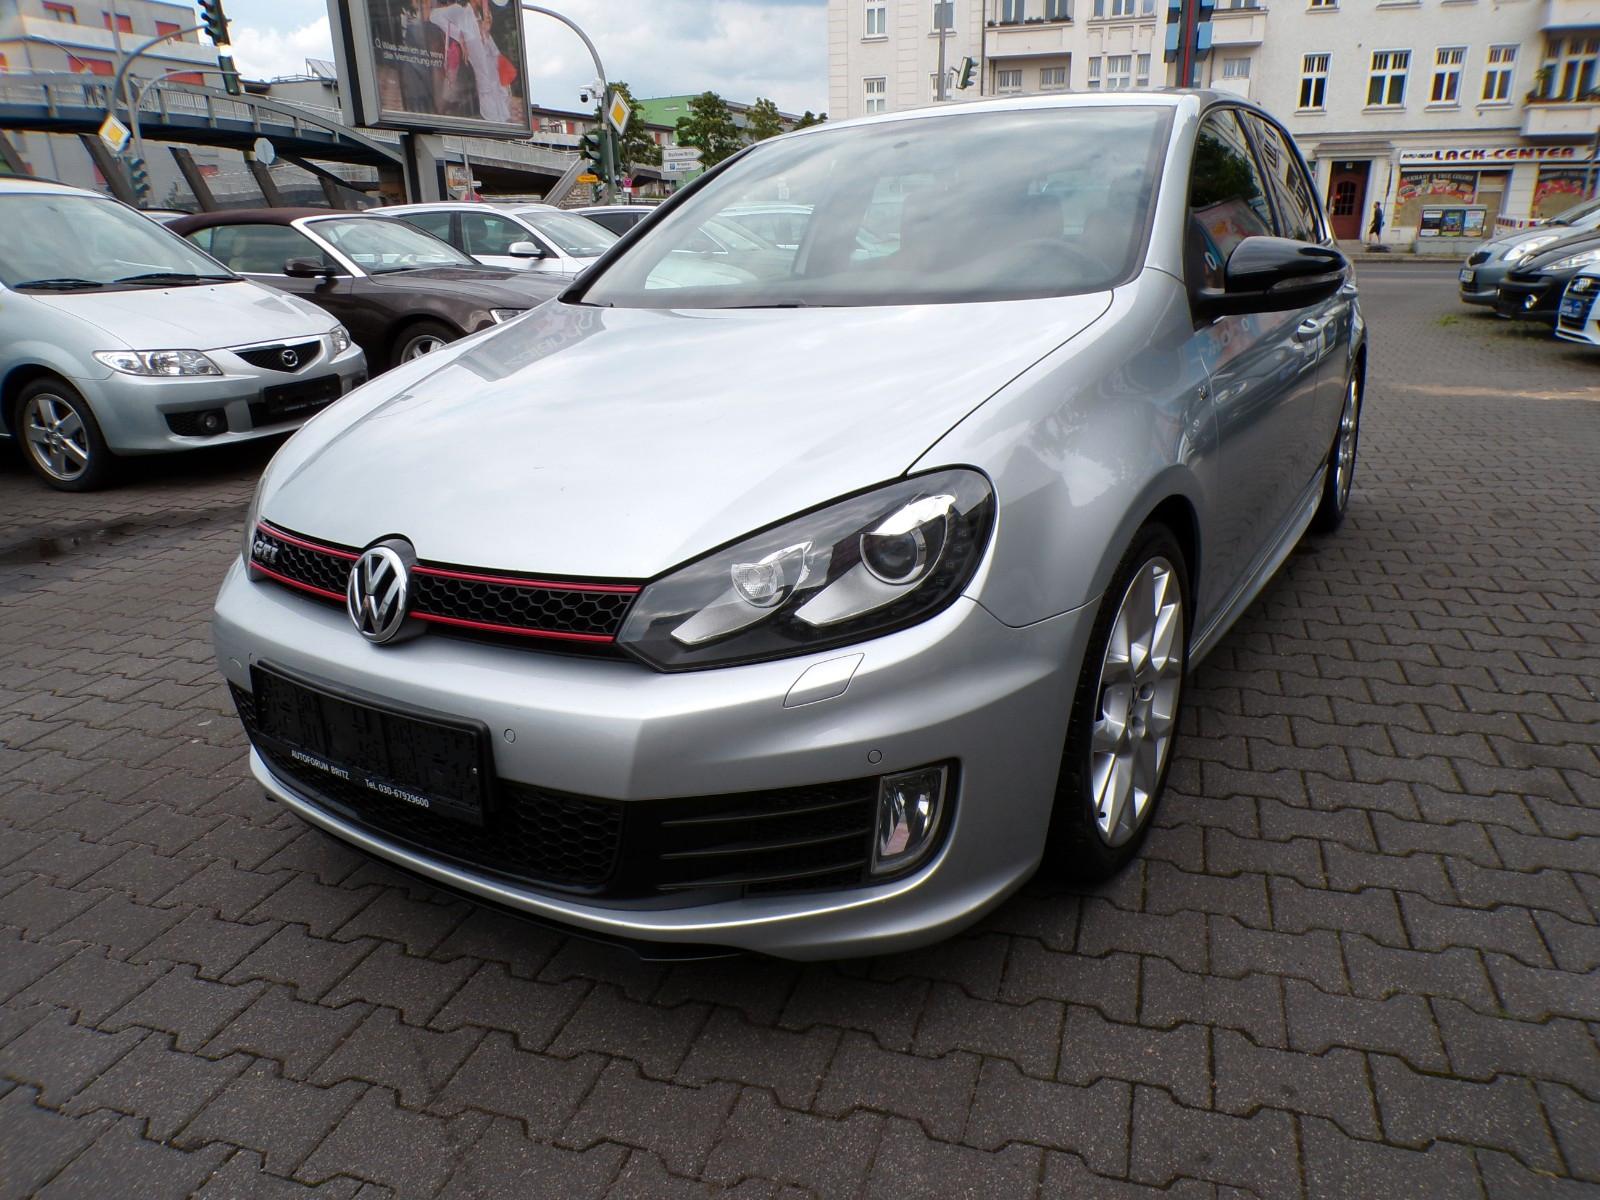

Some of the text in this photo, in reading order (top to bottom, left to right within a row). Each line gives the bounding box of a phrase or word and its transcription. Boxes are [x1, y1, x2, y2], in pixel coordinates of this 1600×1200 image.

[1434, 148, 1574, 160] LACK-CENTER
[254, 540, 278, 562] GTI
[291, 750, 329, 771] AUTOFORUM
[331, 765, 349, 779] BRITZ
[379, 783, 430, 808] 030-67929600
